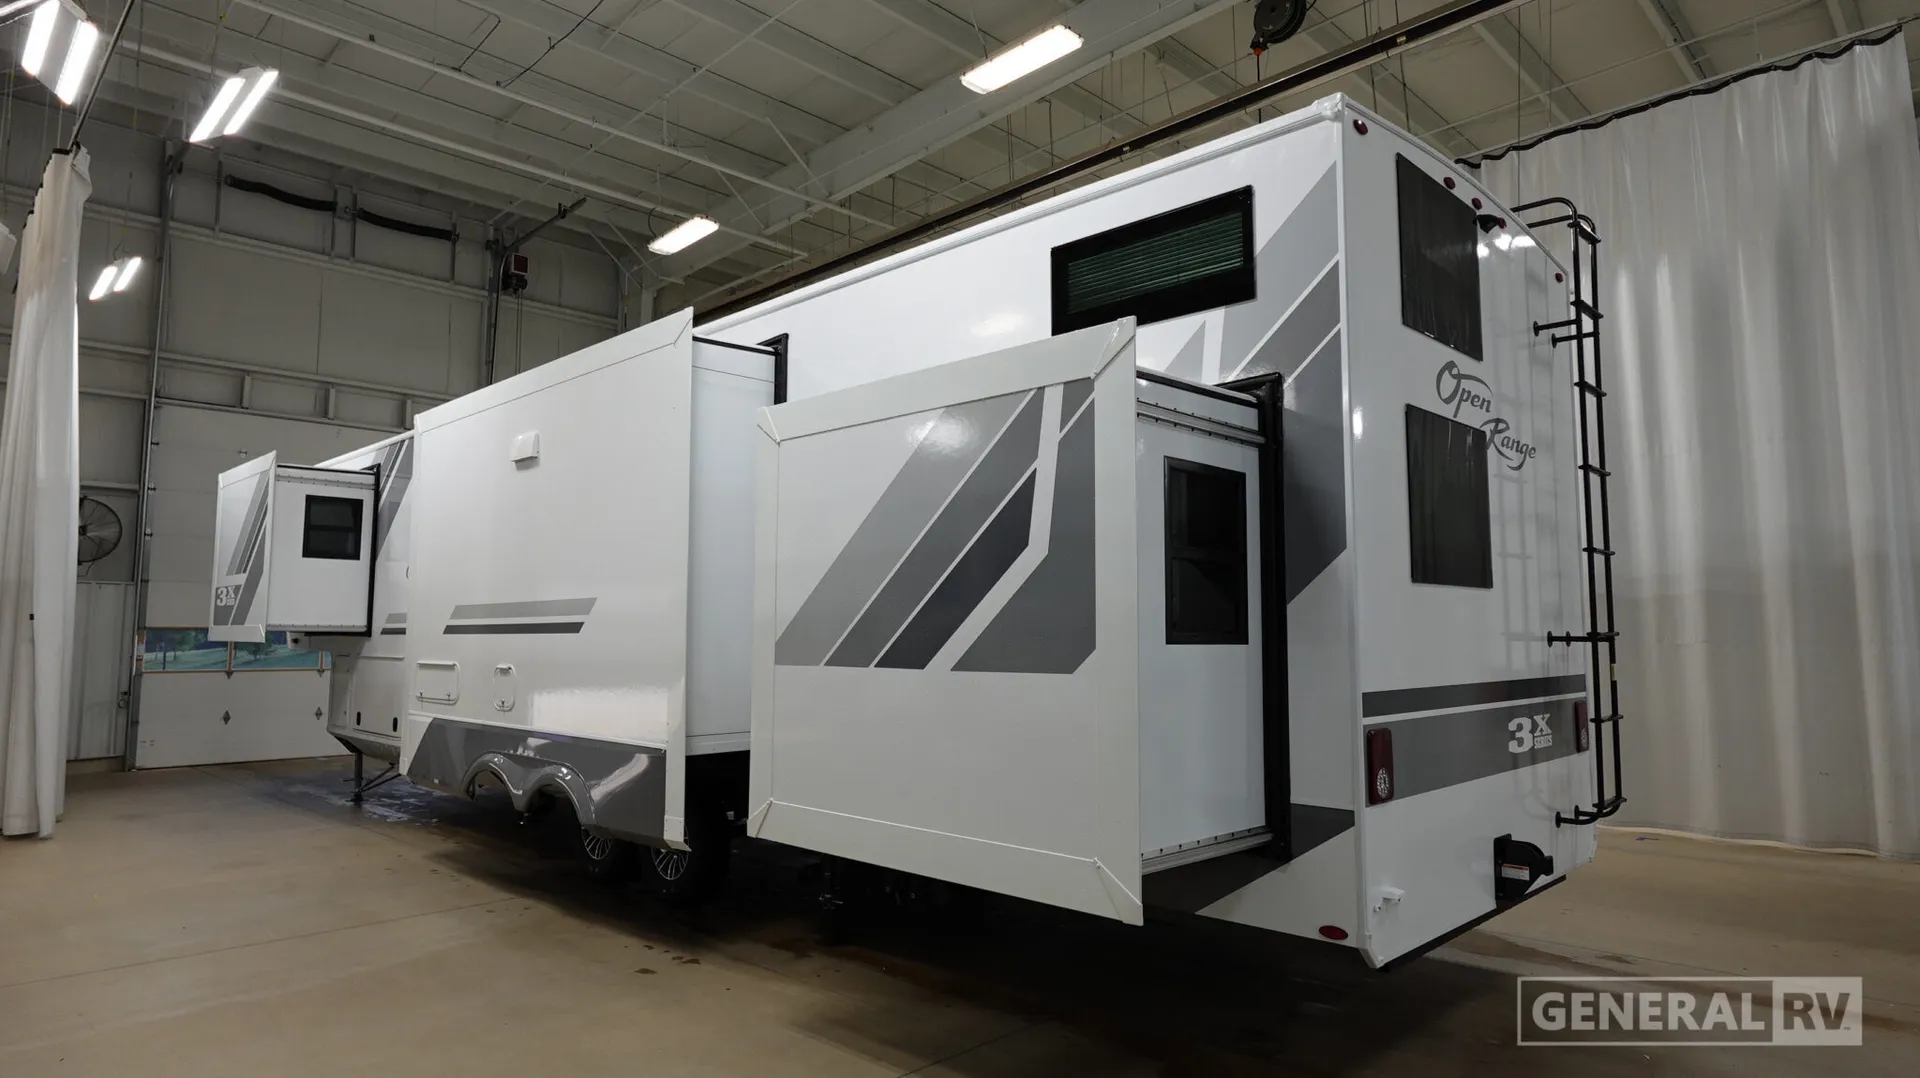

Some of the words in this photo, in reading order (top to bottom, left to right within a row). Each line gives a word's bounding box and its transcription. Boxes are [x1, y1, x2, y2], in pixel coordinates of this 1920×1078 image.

[1436, 360, 1493, 418] Open
[1479, 418, 1537, 471] Range
[1508, 713, 1552, 753] 3X
